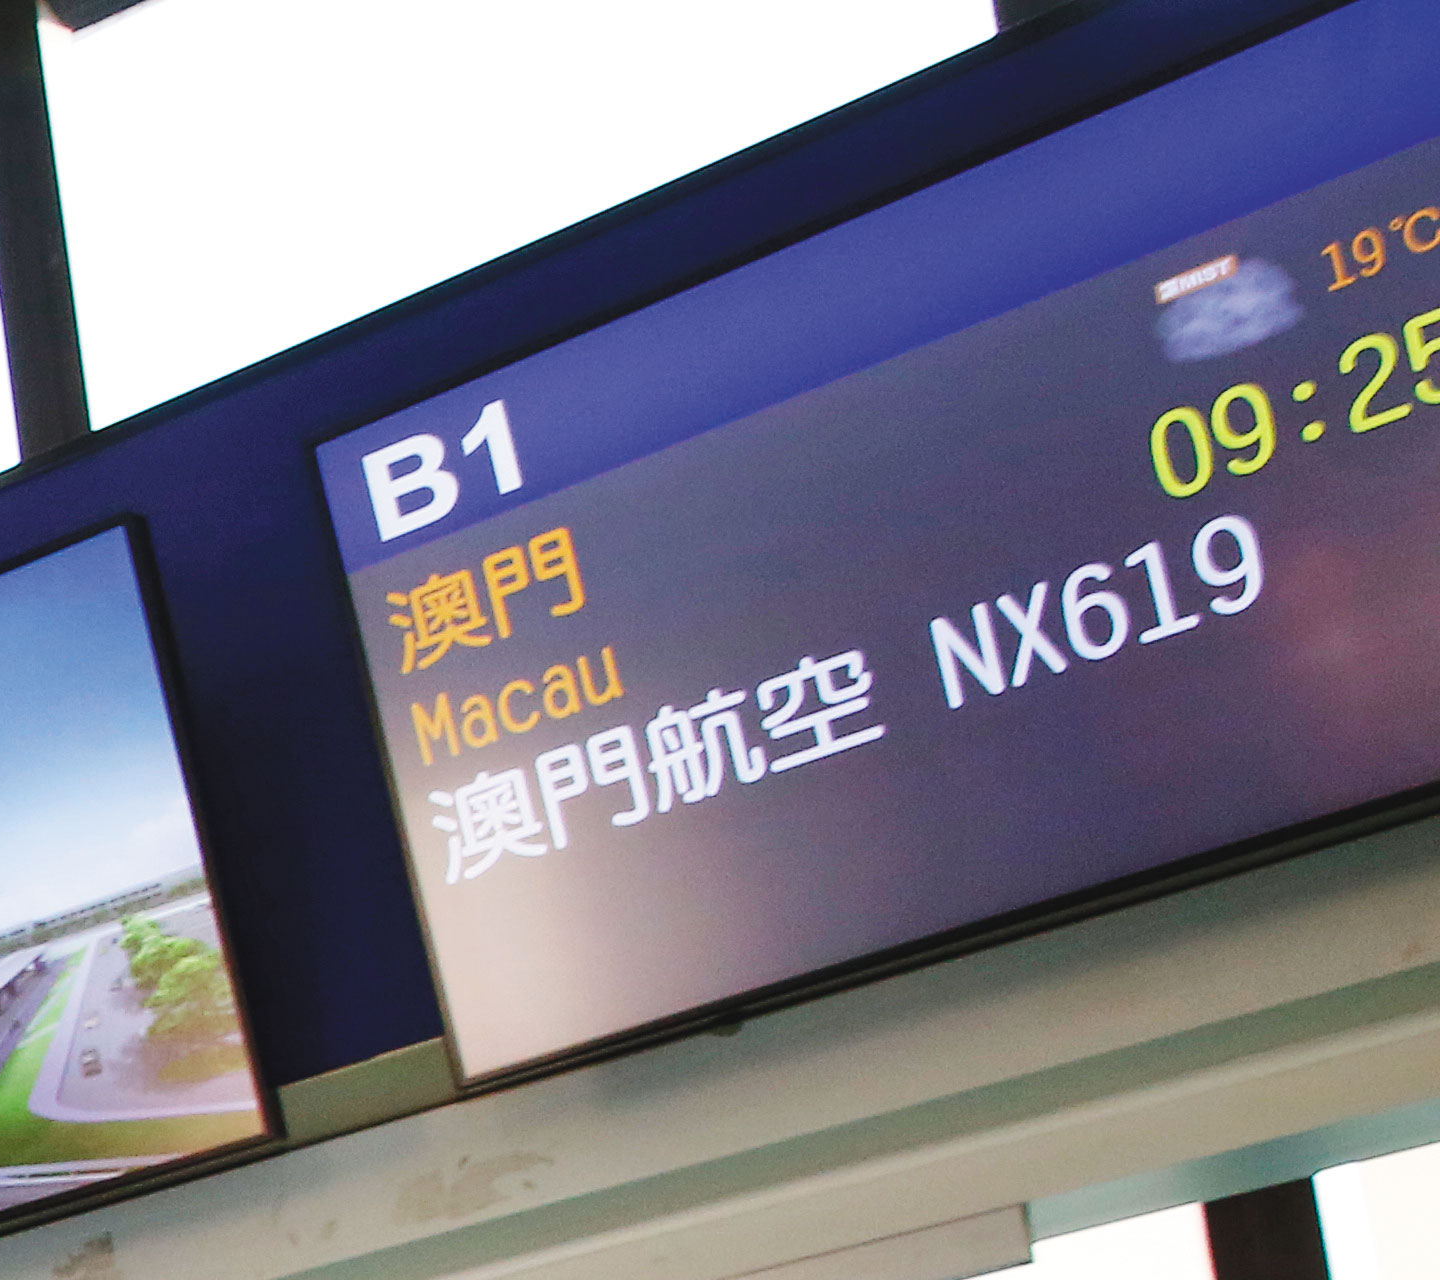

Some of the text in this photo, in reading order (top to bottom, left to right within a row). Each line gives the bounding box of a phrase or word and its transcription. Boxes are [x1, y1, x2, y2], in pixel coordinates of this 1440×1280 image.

[361, 400, 524, 542] B1
[1149, 303, 1440, 499] 09:25
[385, 527, 586, 675] 澳門
[411, 644, 625, 767] Macau
[431, 515, 1265, 883] 澳門航空 NX619
